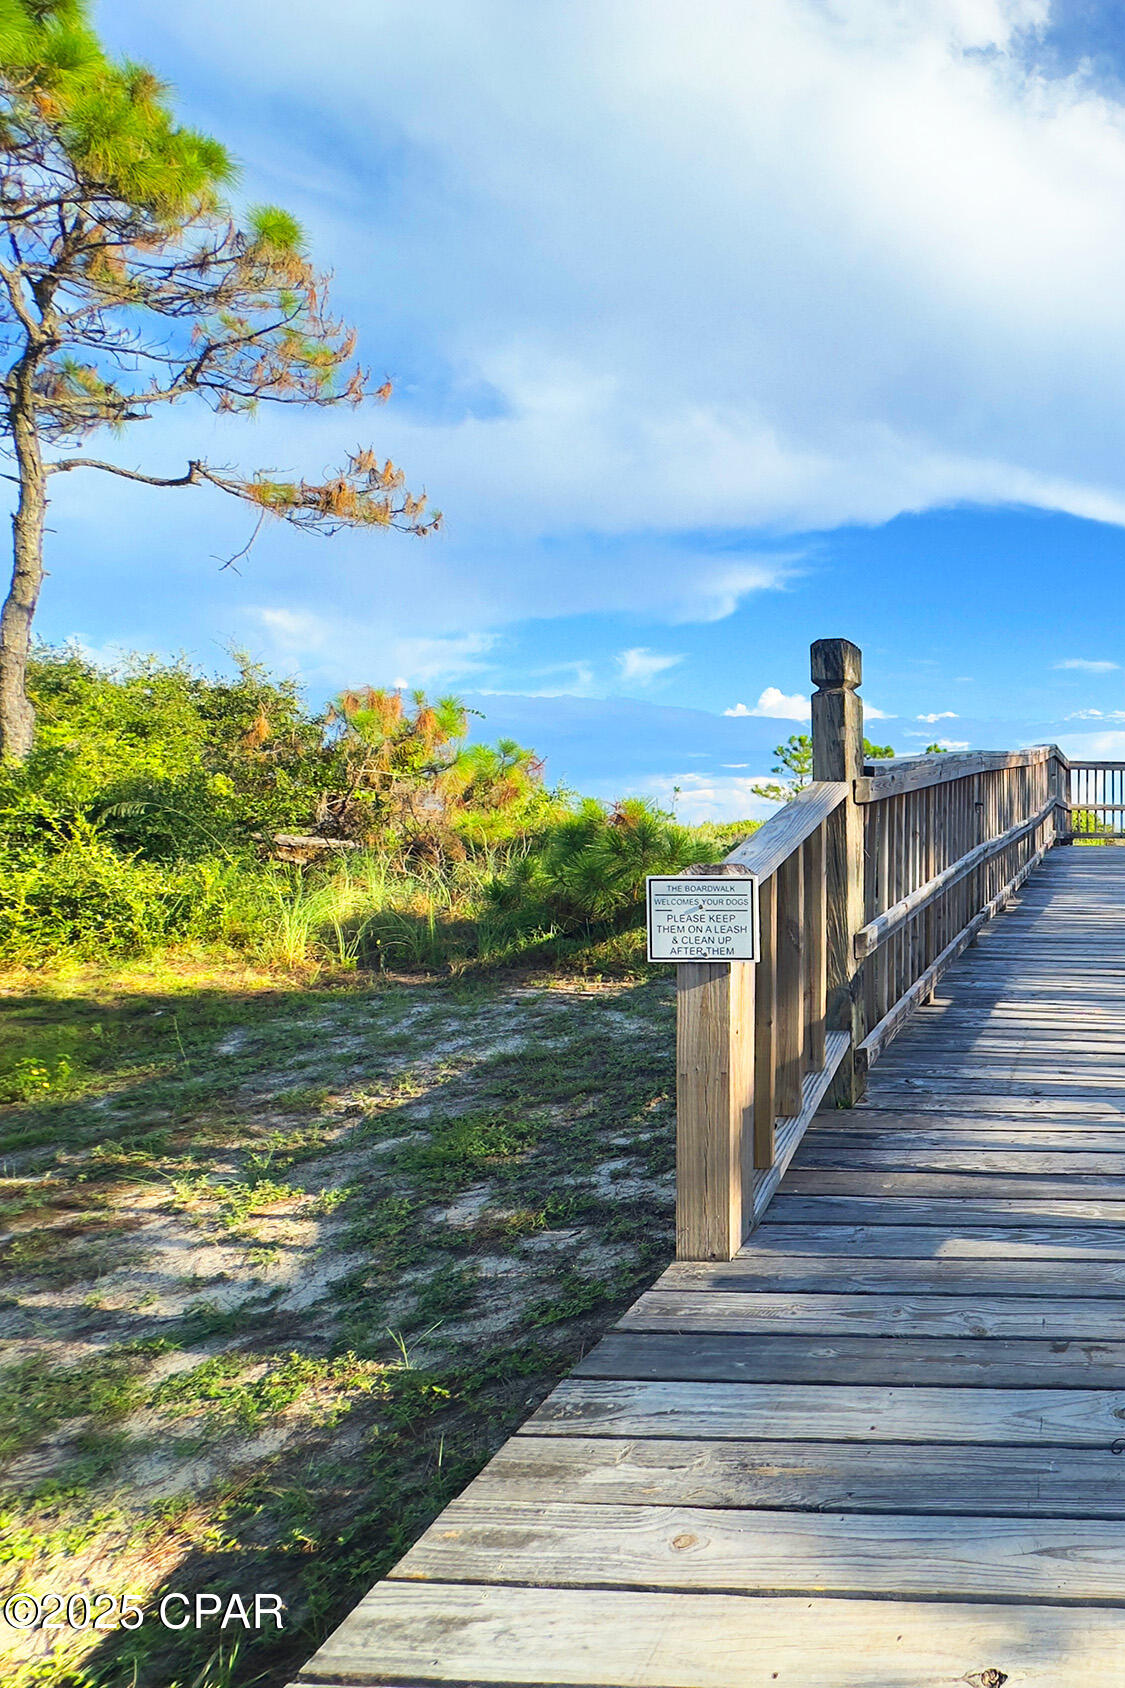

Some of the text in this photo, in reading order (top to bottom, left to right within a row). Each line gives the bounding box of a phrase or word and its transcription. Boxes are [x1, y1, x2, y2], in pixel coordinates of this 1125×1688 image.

[667, 914, 736, 922] PLEASE KEEP
[688, 925, 702, 933] ON
[681, 936, 714, 944] CLEAN
[718, 936, 731, 944] UP
[670, 947, 703, 955] AFTER
